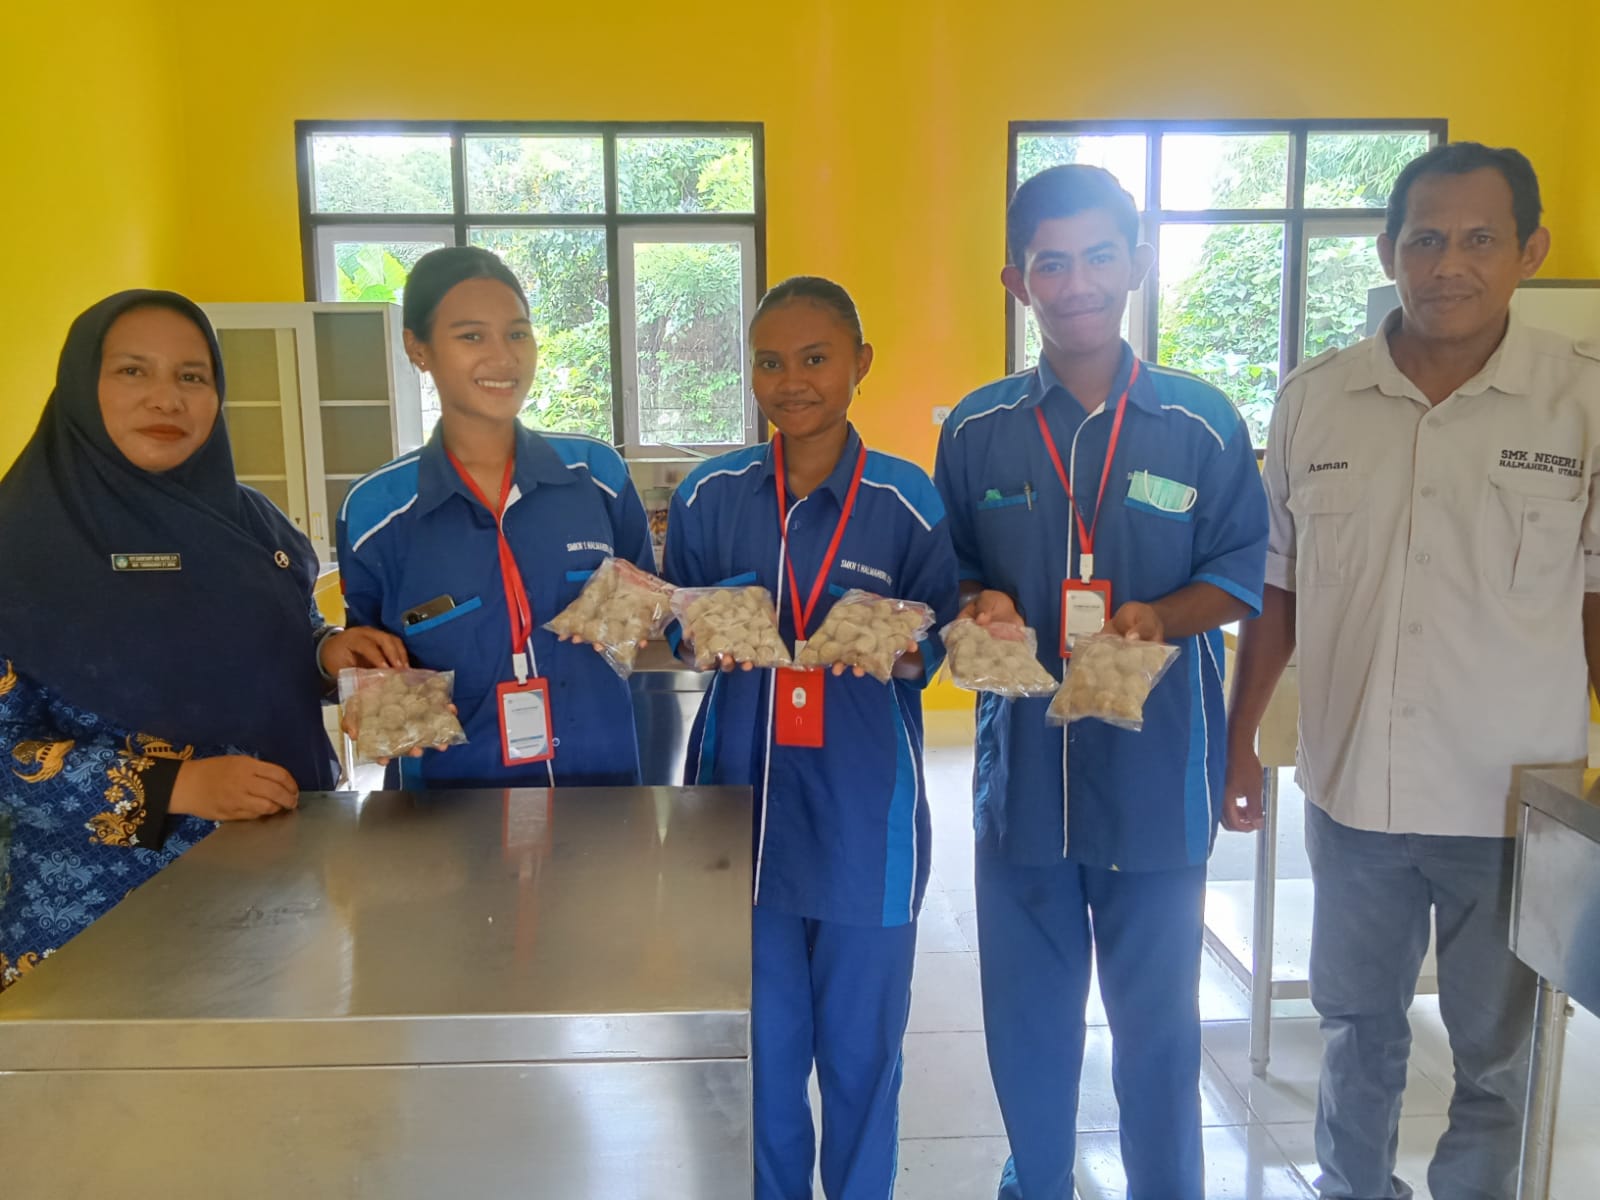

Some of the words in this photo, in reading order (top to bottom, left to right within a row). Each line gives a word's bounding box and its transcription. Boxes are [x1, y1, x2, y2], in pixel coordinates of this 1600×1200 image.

[1501, 449, 1528, 461] SMK
[1534, 453, 1577, 468] NEGERI
[1308, 461, 1348, 473] Asman
[1500, 460, 1554, 473] HALMAHERA
